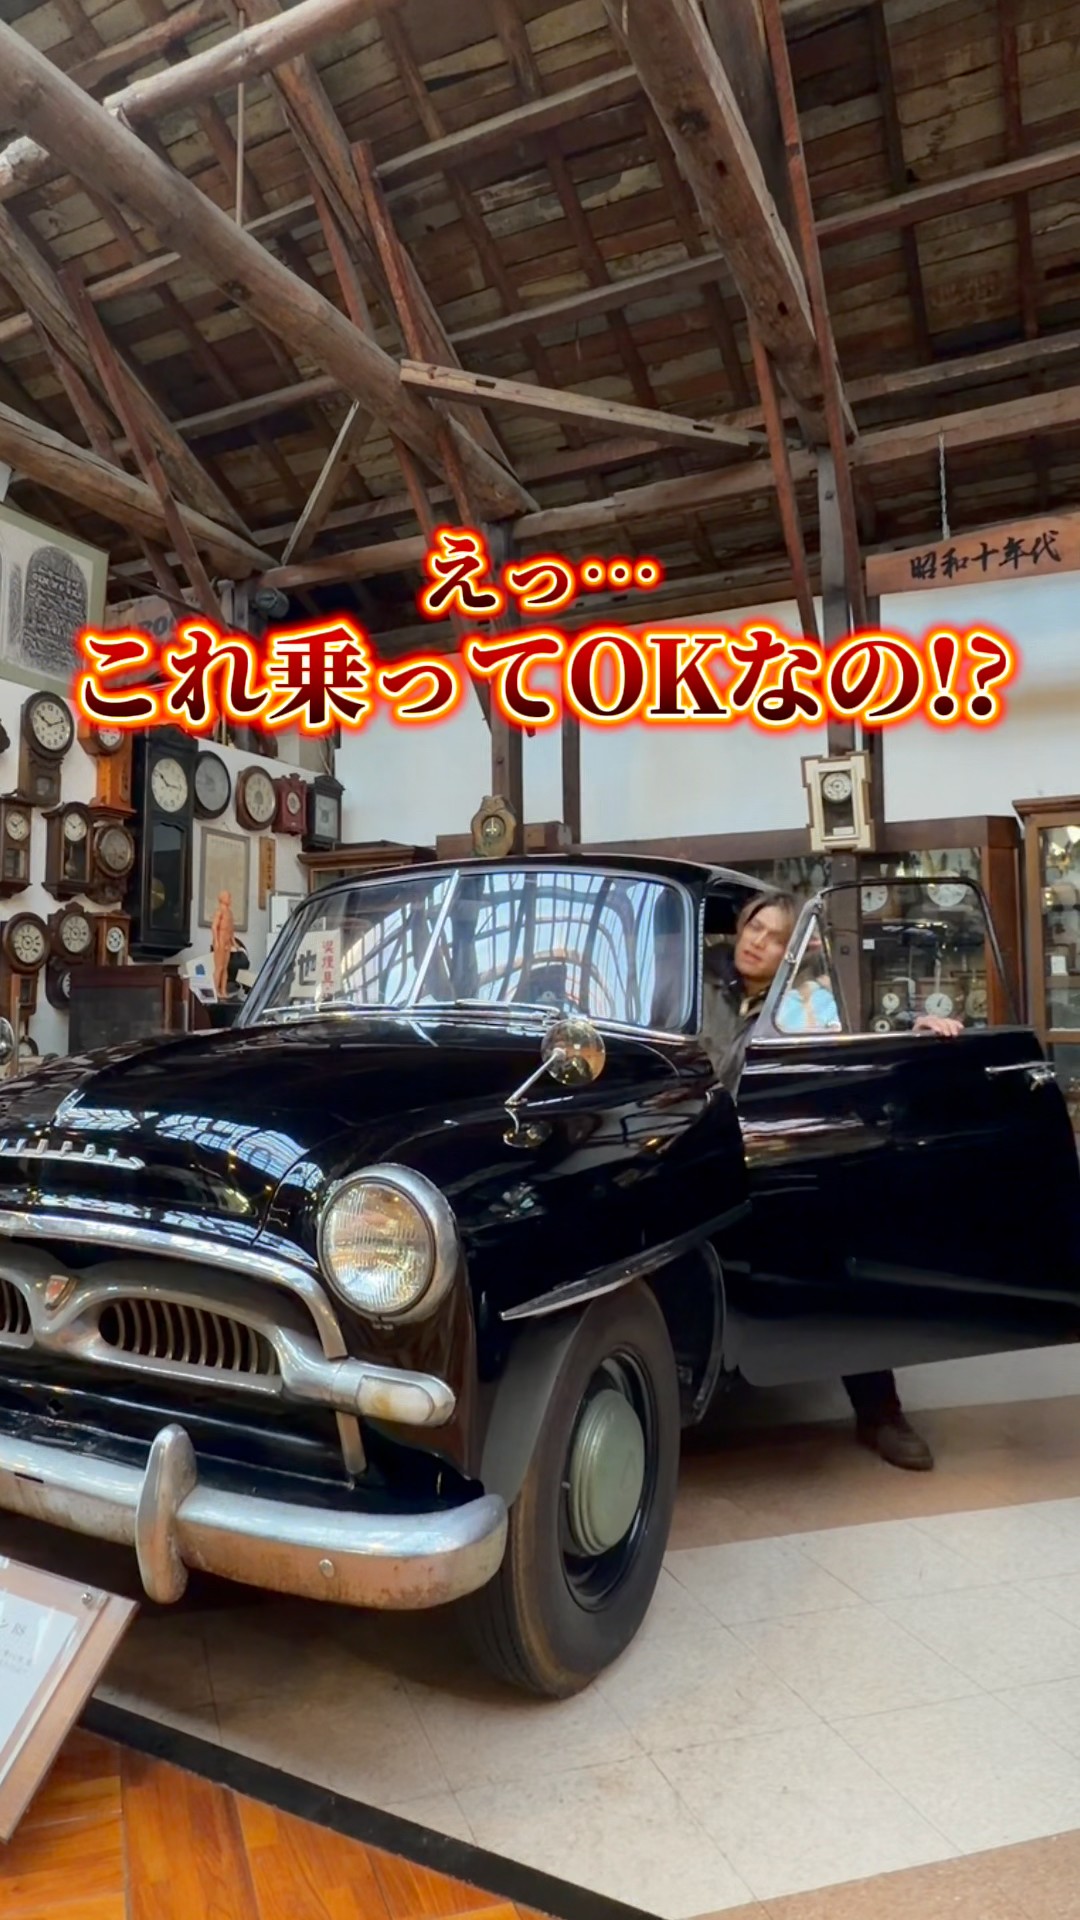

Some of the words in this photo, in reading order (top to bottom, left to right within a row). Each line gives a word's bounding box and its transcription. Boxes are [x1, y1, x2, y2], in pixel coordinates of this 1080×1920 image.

[909, 530, 1062, 580] 昭和十年代
